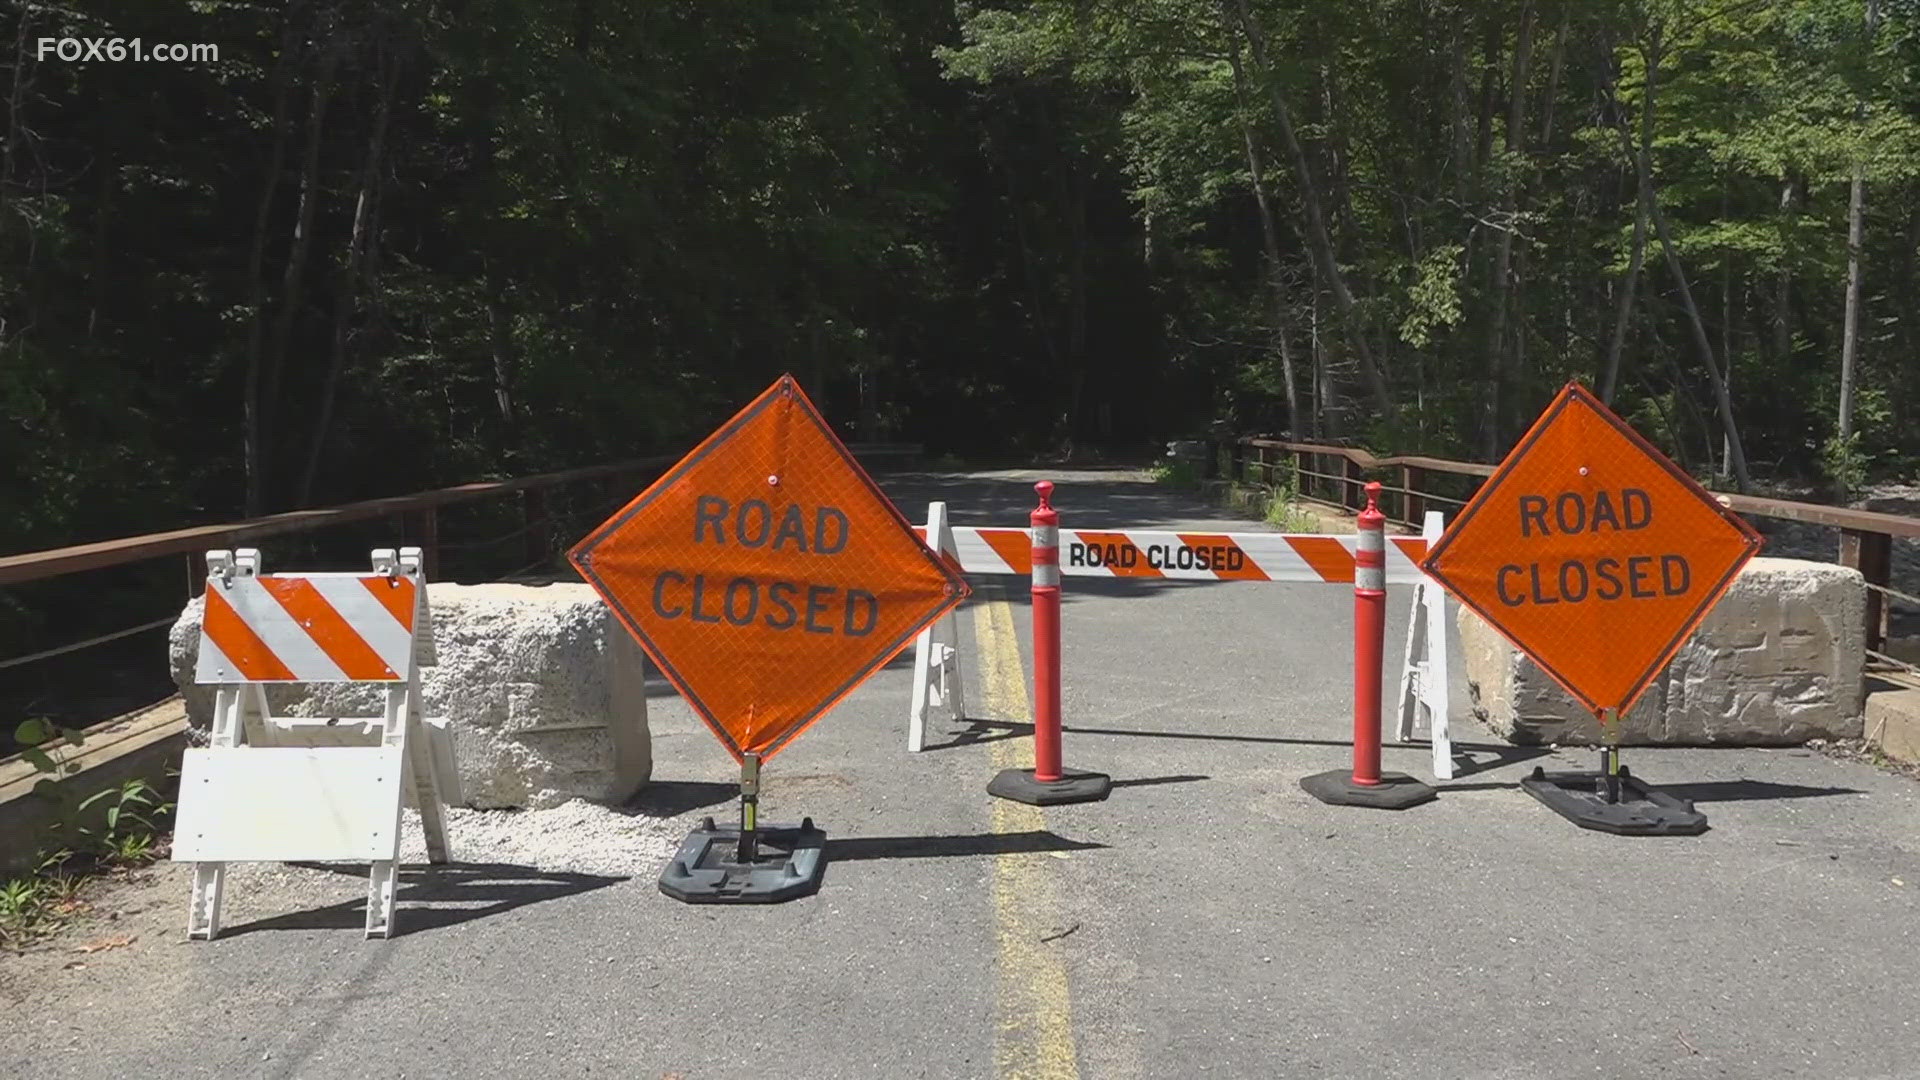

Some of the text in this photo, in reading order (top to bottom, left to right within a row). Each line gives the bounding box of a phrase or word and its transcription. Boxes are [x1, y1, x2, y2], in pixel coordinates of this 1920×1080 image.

[694, 495, 850, 555] ROAD
[1519, 488, 1652, 538] ROAD
[1070, 543, 1244, 571] ROAD CLOSED
[1496, 554, 1691, 607] CLOSED
[652, 570, 879, 637] CLOSED
